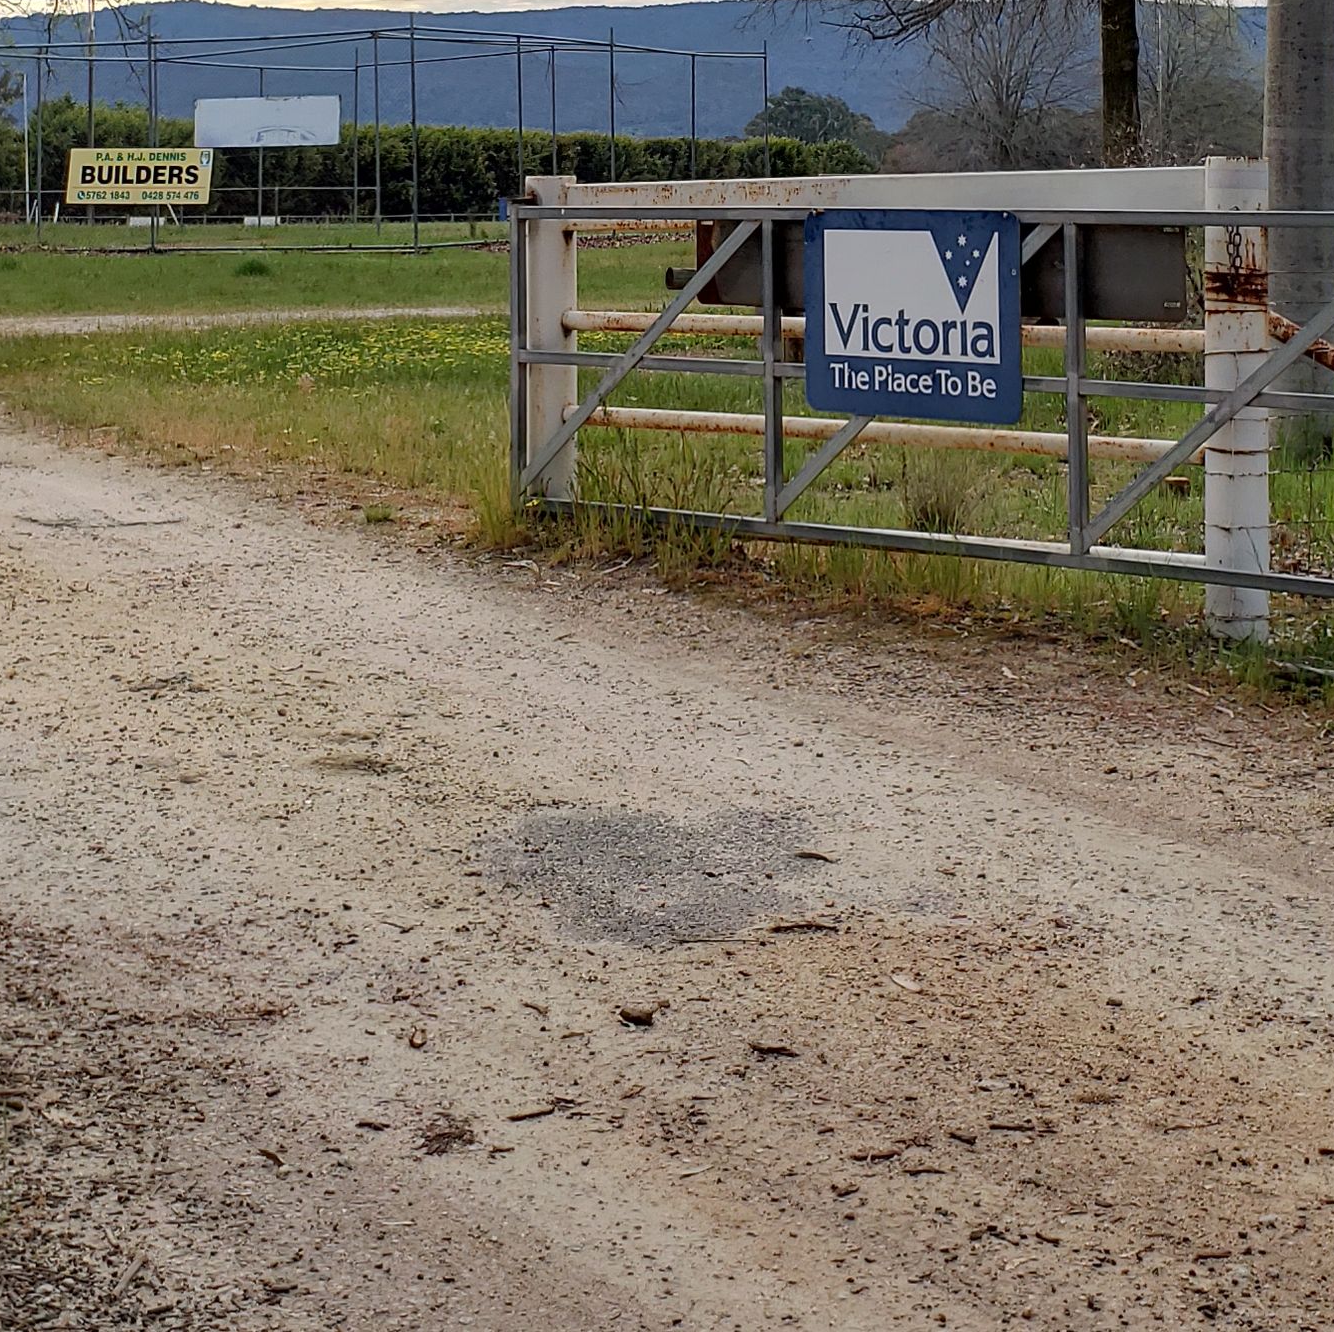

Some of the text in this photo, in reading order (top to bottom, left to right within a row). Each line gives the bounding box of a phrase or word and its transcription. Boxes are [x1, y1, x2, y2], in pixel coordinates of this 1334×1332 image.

[96, 152, 187, 162] P.A. & H.J. DENNIS
[81, 165, 200, 185] BUILDERS
[86, 190, 107, 200] 5762
[141, 190, 164, 200] 0428
[166, 190, 181, 200] 574
[183, 190, 200, 200] 476
[828, 302, 995, 358] Victoria
[829, 362, 997, 399] The Place To Be
